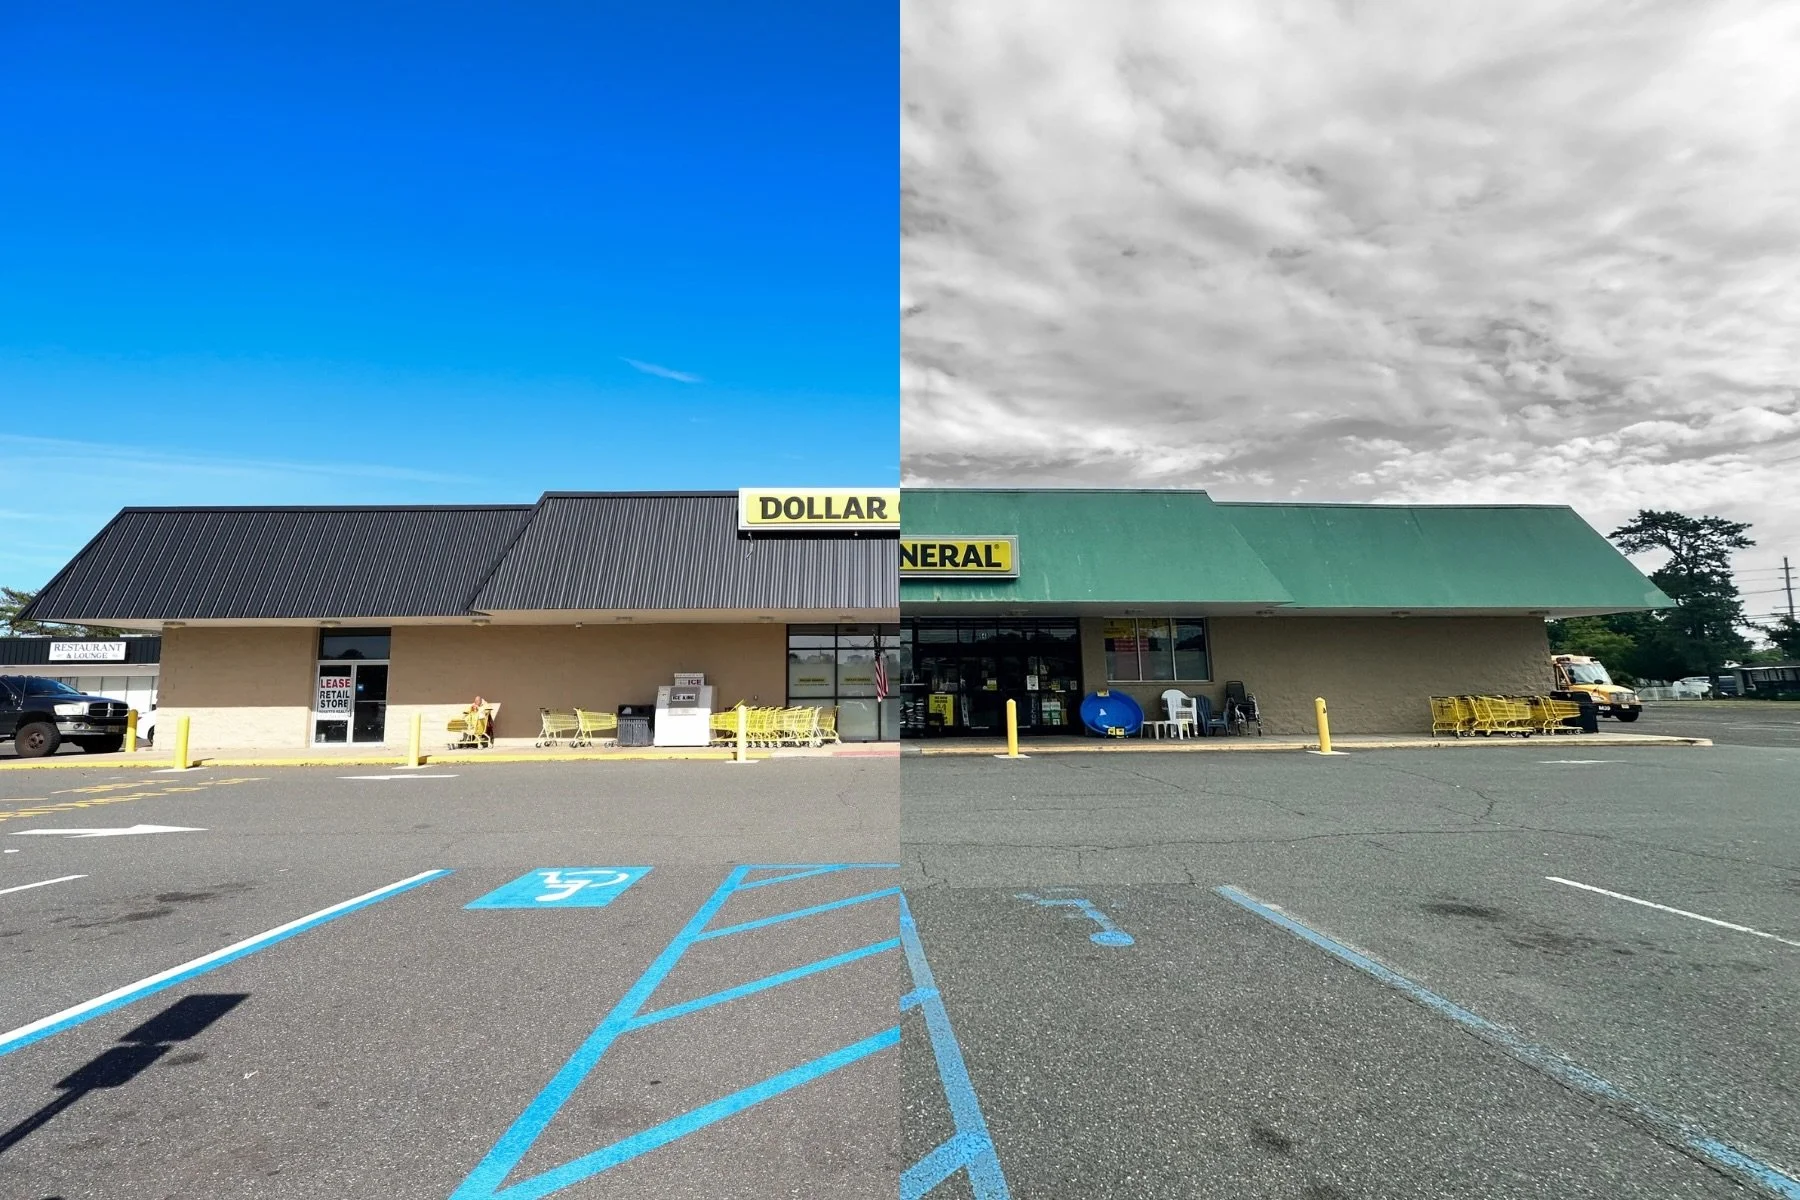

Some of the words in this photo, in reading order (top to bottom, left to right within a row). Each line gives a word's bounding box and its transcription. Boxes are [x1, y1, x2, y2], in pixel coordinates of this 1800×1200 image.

[760, 496, 887, 520] DOLLAR
[54, 643, 122, 652] RESTAURANT
[320, 679, 350, 688] LEASE
[320, 690, 350, 698] RETAIL
[320, 700, 348, 708] STORE
